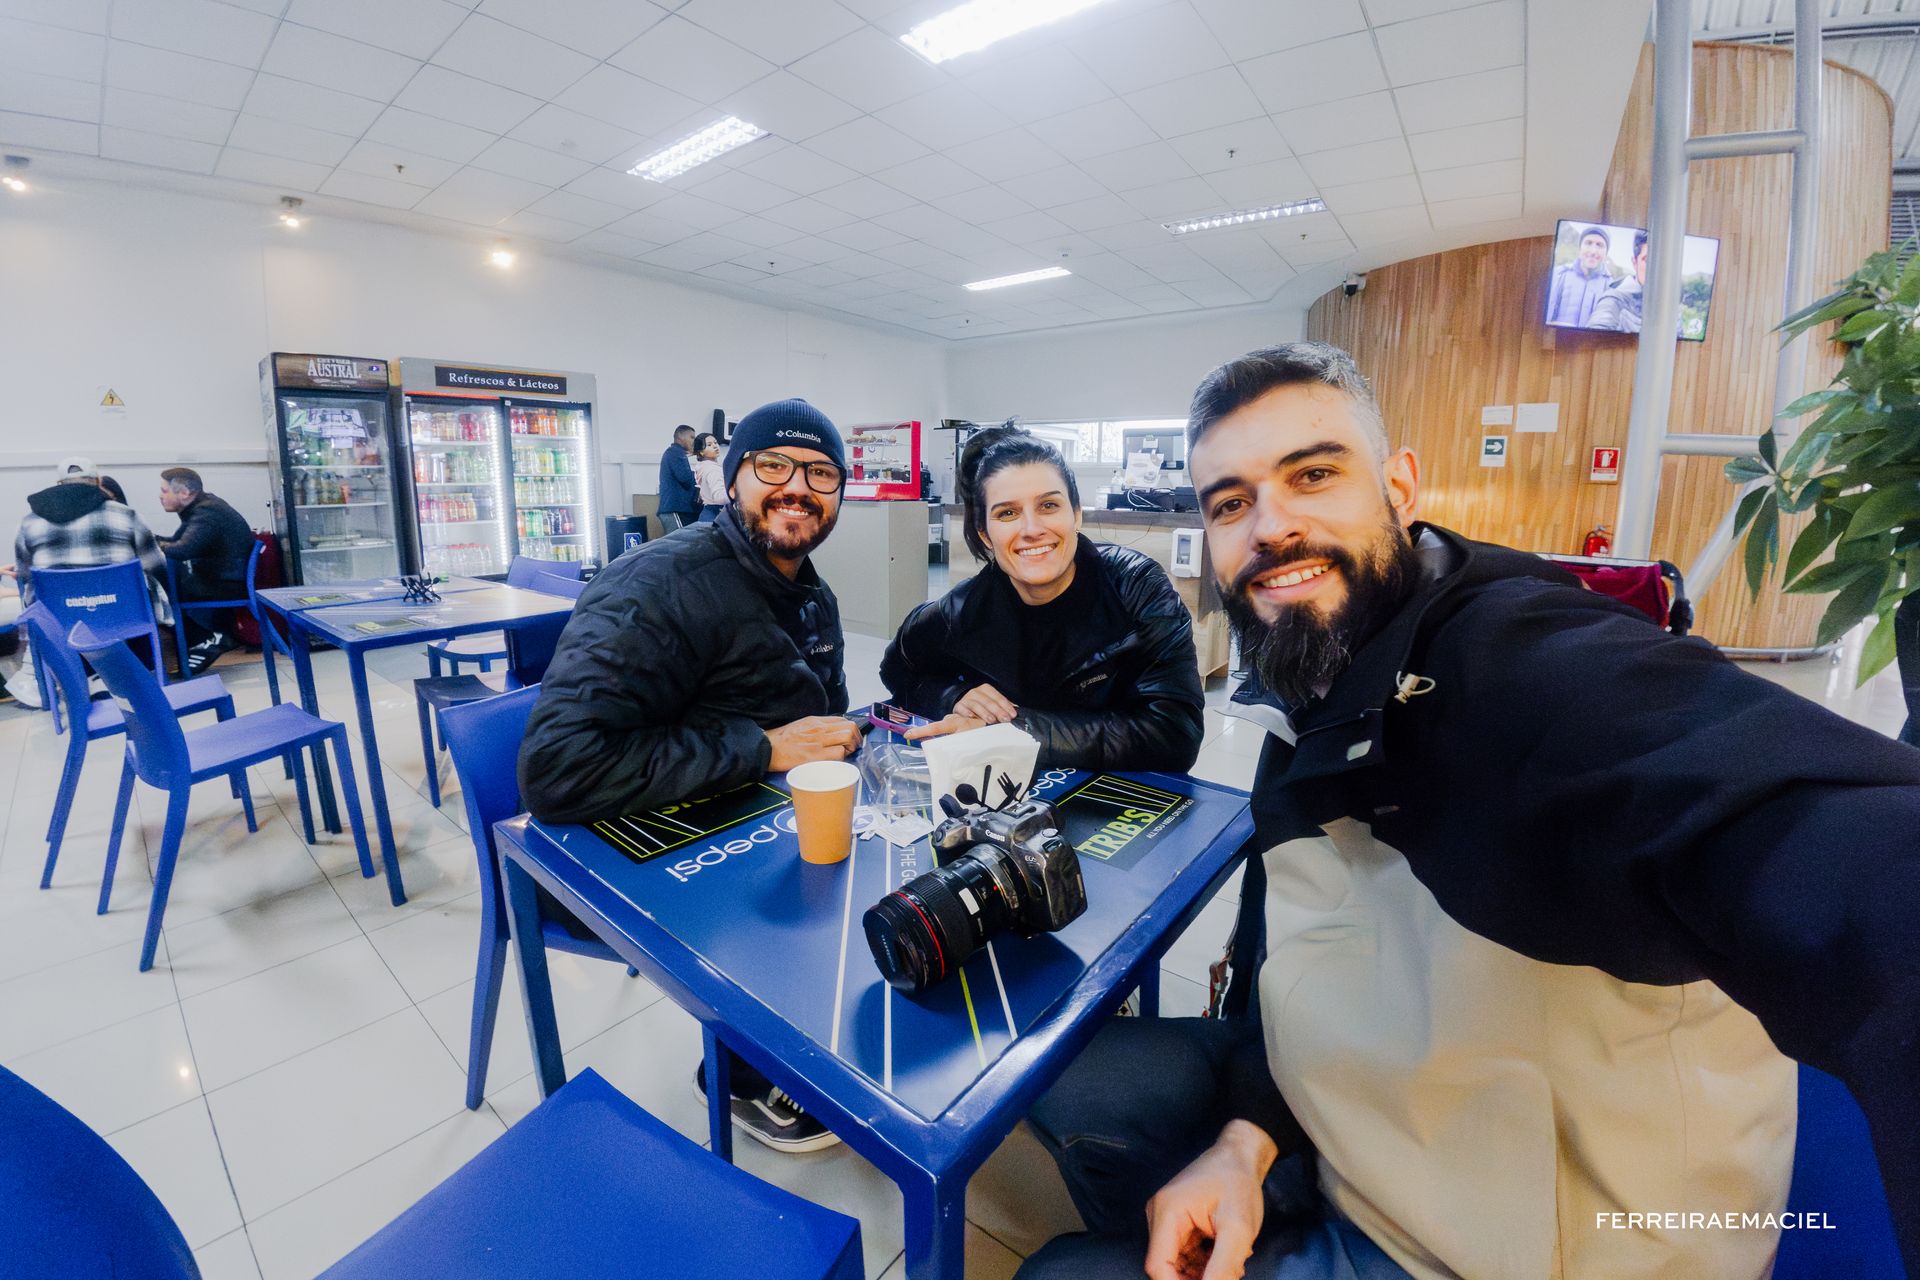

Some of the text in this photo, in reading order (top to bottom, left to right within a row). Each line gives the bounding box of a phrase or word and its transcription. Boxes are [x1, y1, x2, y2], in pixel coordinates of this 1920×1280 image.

[307, 357, 361, 379] AUSTRAL
[449, 372, 560, 390] Refrescos & Lácteos
[785, 429, 821, 443] Columbia
[1081, 809, 1156, 859] TRIB'S
[664, 825, 779, 883] pepsi
[900, 847, 917, 867] THE
